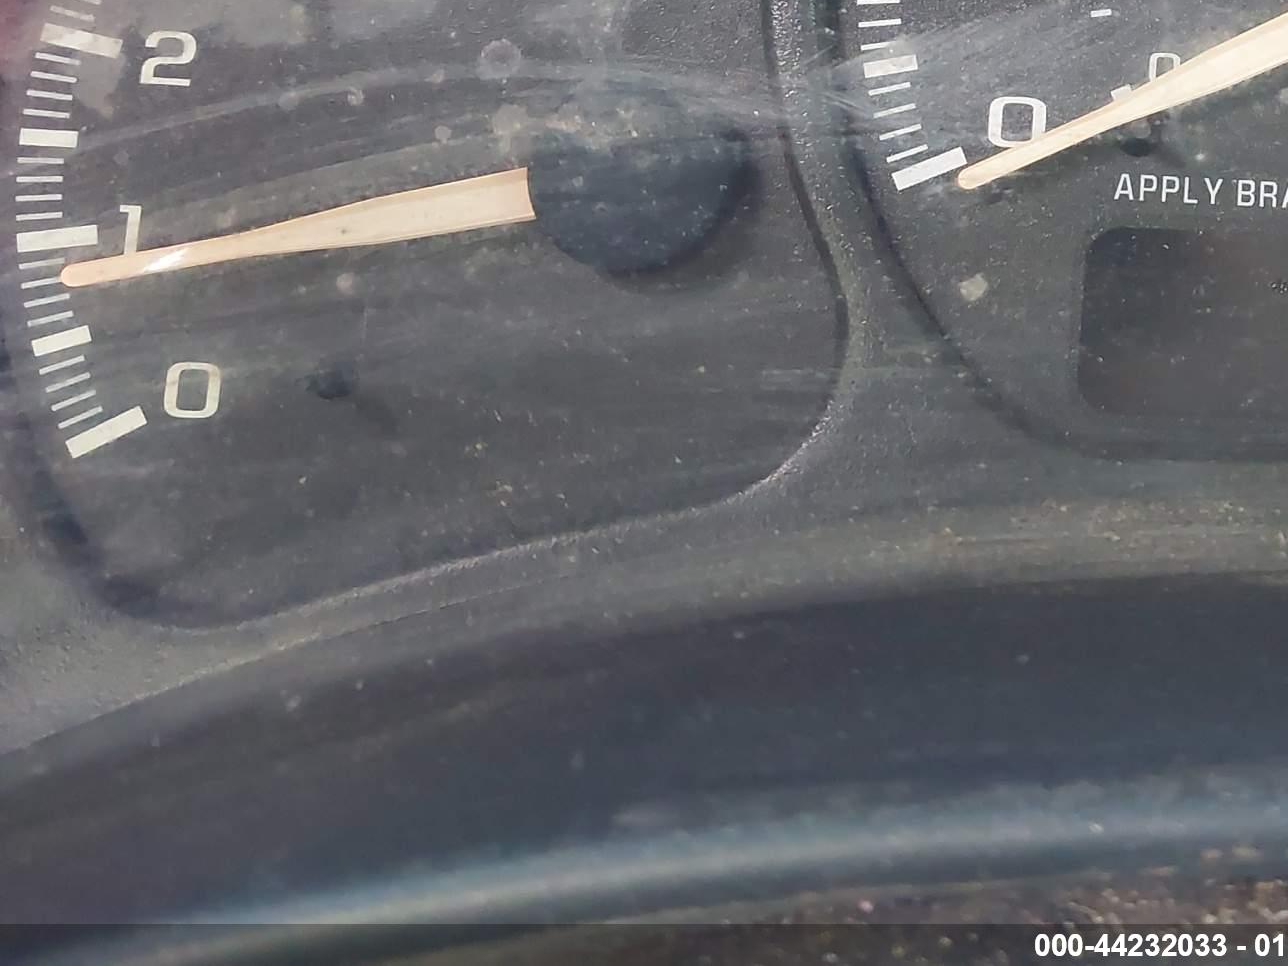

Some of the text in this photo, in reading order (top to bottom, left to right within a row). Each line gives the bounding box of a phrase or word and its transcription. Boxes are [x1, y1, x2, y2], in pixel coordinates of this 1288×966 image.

[139, 30, 197, 87] 2
[987, 96, 1046, 148] 0
[1114, 173, 1223, 206] APPLY
[119, 204, 142, 257] 1
[163, 362, 223, 419] 0
